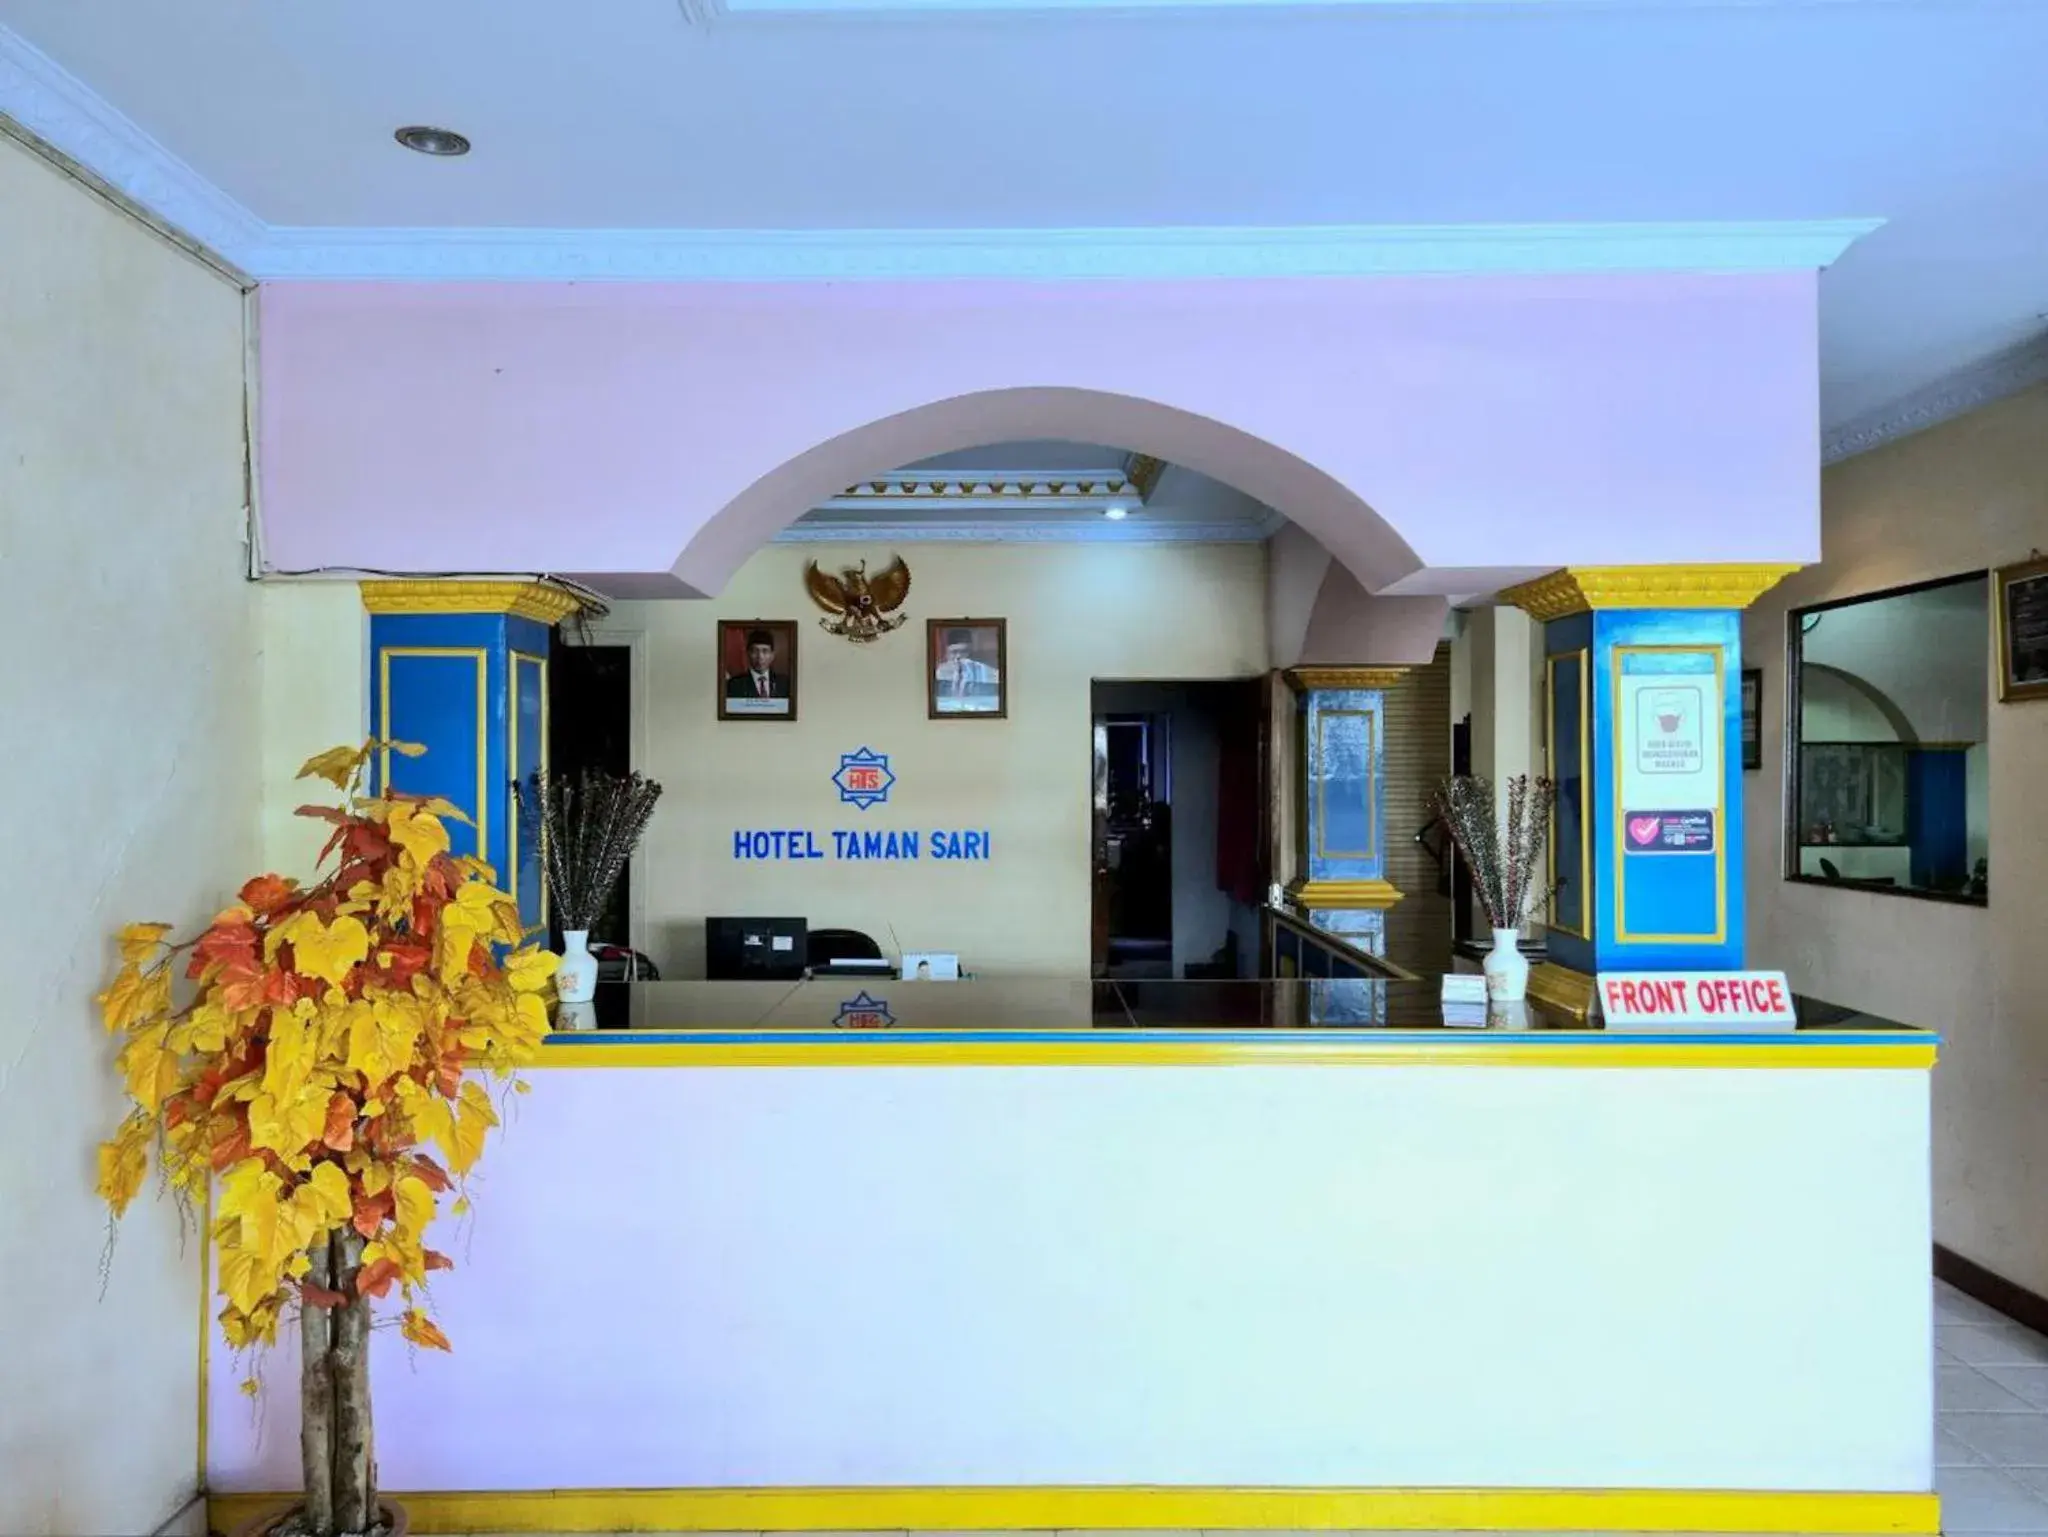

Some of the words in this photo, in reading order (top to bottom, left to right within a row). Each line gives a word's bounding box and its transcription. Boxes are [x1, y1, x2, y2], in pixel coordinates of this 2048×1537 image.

[733, 830, 823, 859] HOTEL
[832, 830, 919, 859] TAMAN
[930, 830, 990, 859] SARI
[1605, 980, 1688, 1014] FRONT
[1697, 979, 1786, 1013] OFFICE
